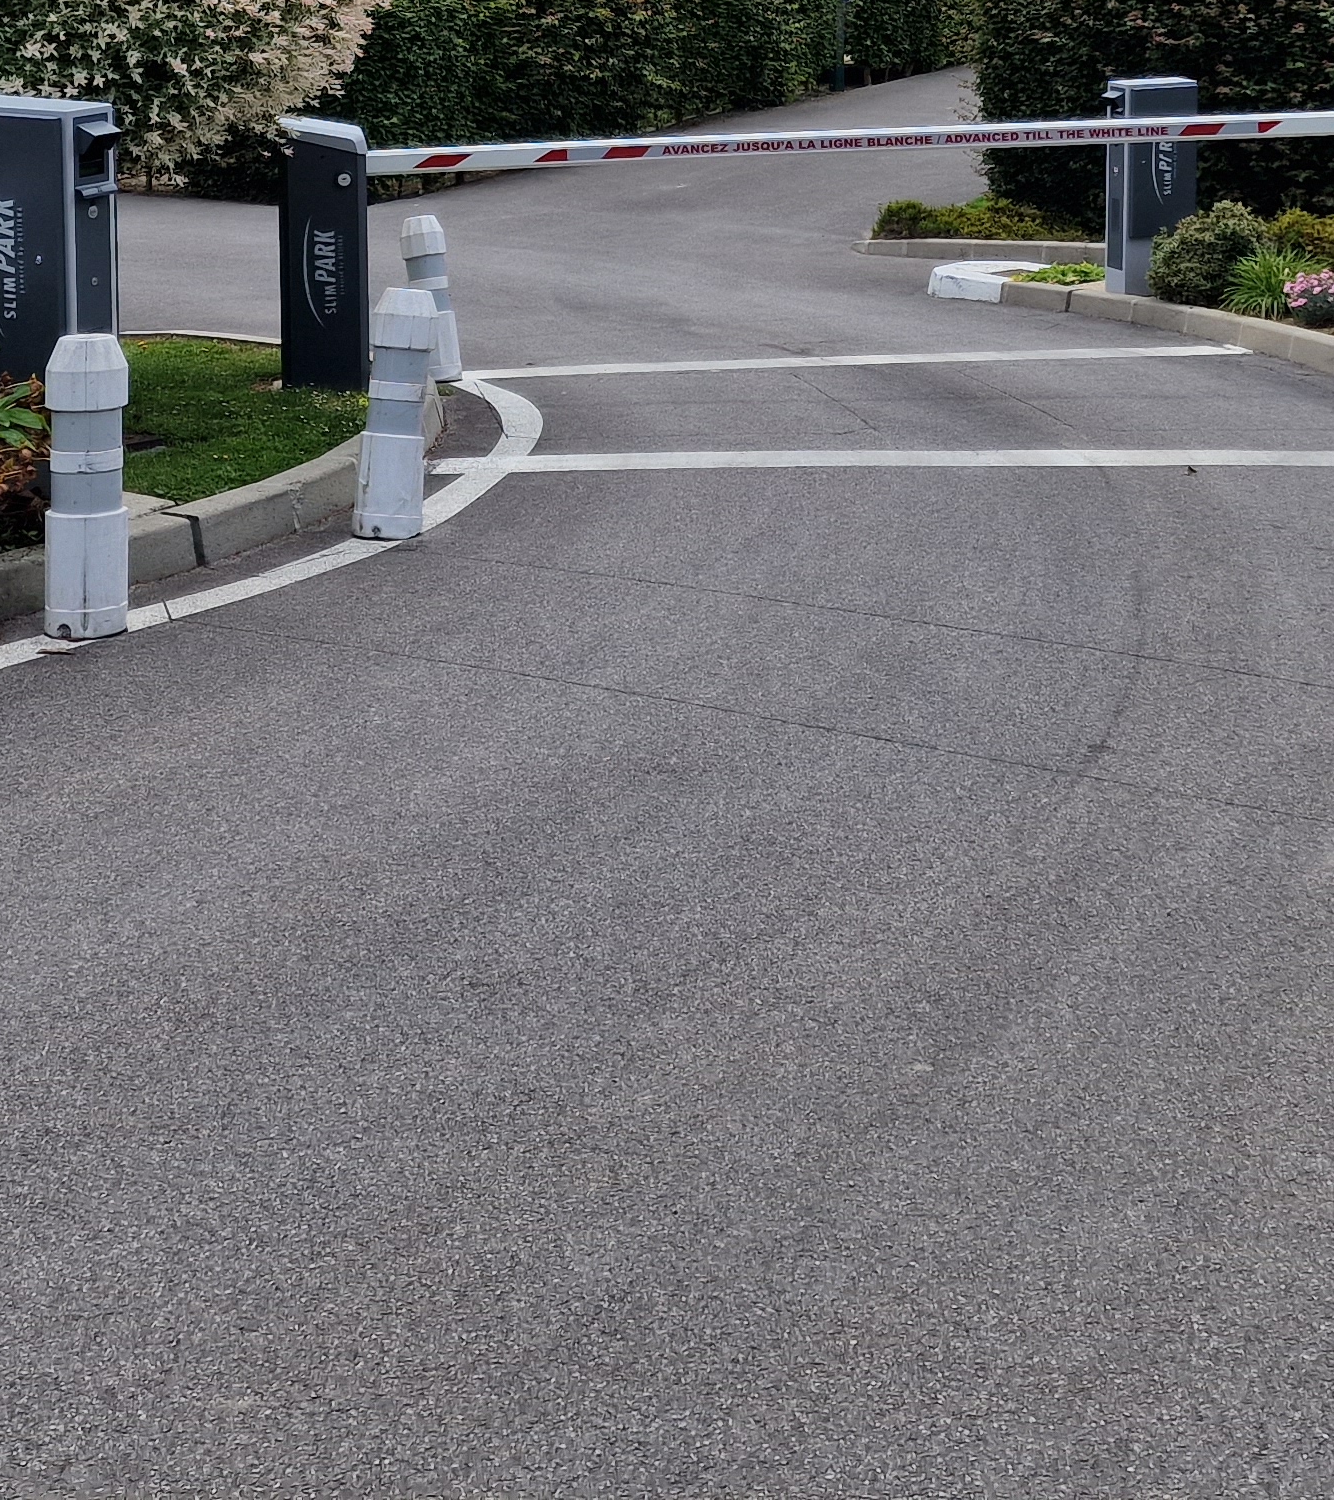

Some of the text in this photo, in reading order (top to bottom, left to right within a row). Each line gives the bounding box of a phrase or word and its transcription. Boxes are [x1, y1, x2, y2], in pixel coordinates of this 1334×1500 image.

[662, 143, 729, 156] AVANCEZ
[733, 140, 795, 153] JUSQU'A
[798, 139, 817, 150] LA
[820, 138, 864, 149] LIGNE
[867, 135, 933, 147] BLANCHE
[944, 132, 1020, 144] ADVANCED
[1023, 130, 1054, 141] TILL
[1057, 129, 1085, 140] THE
[1089, 127, 1134, 139] WHITE
[1137, 126, 1170, 137] LINE
